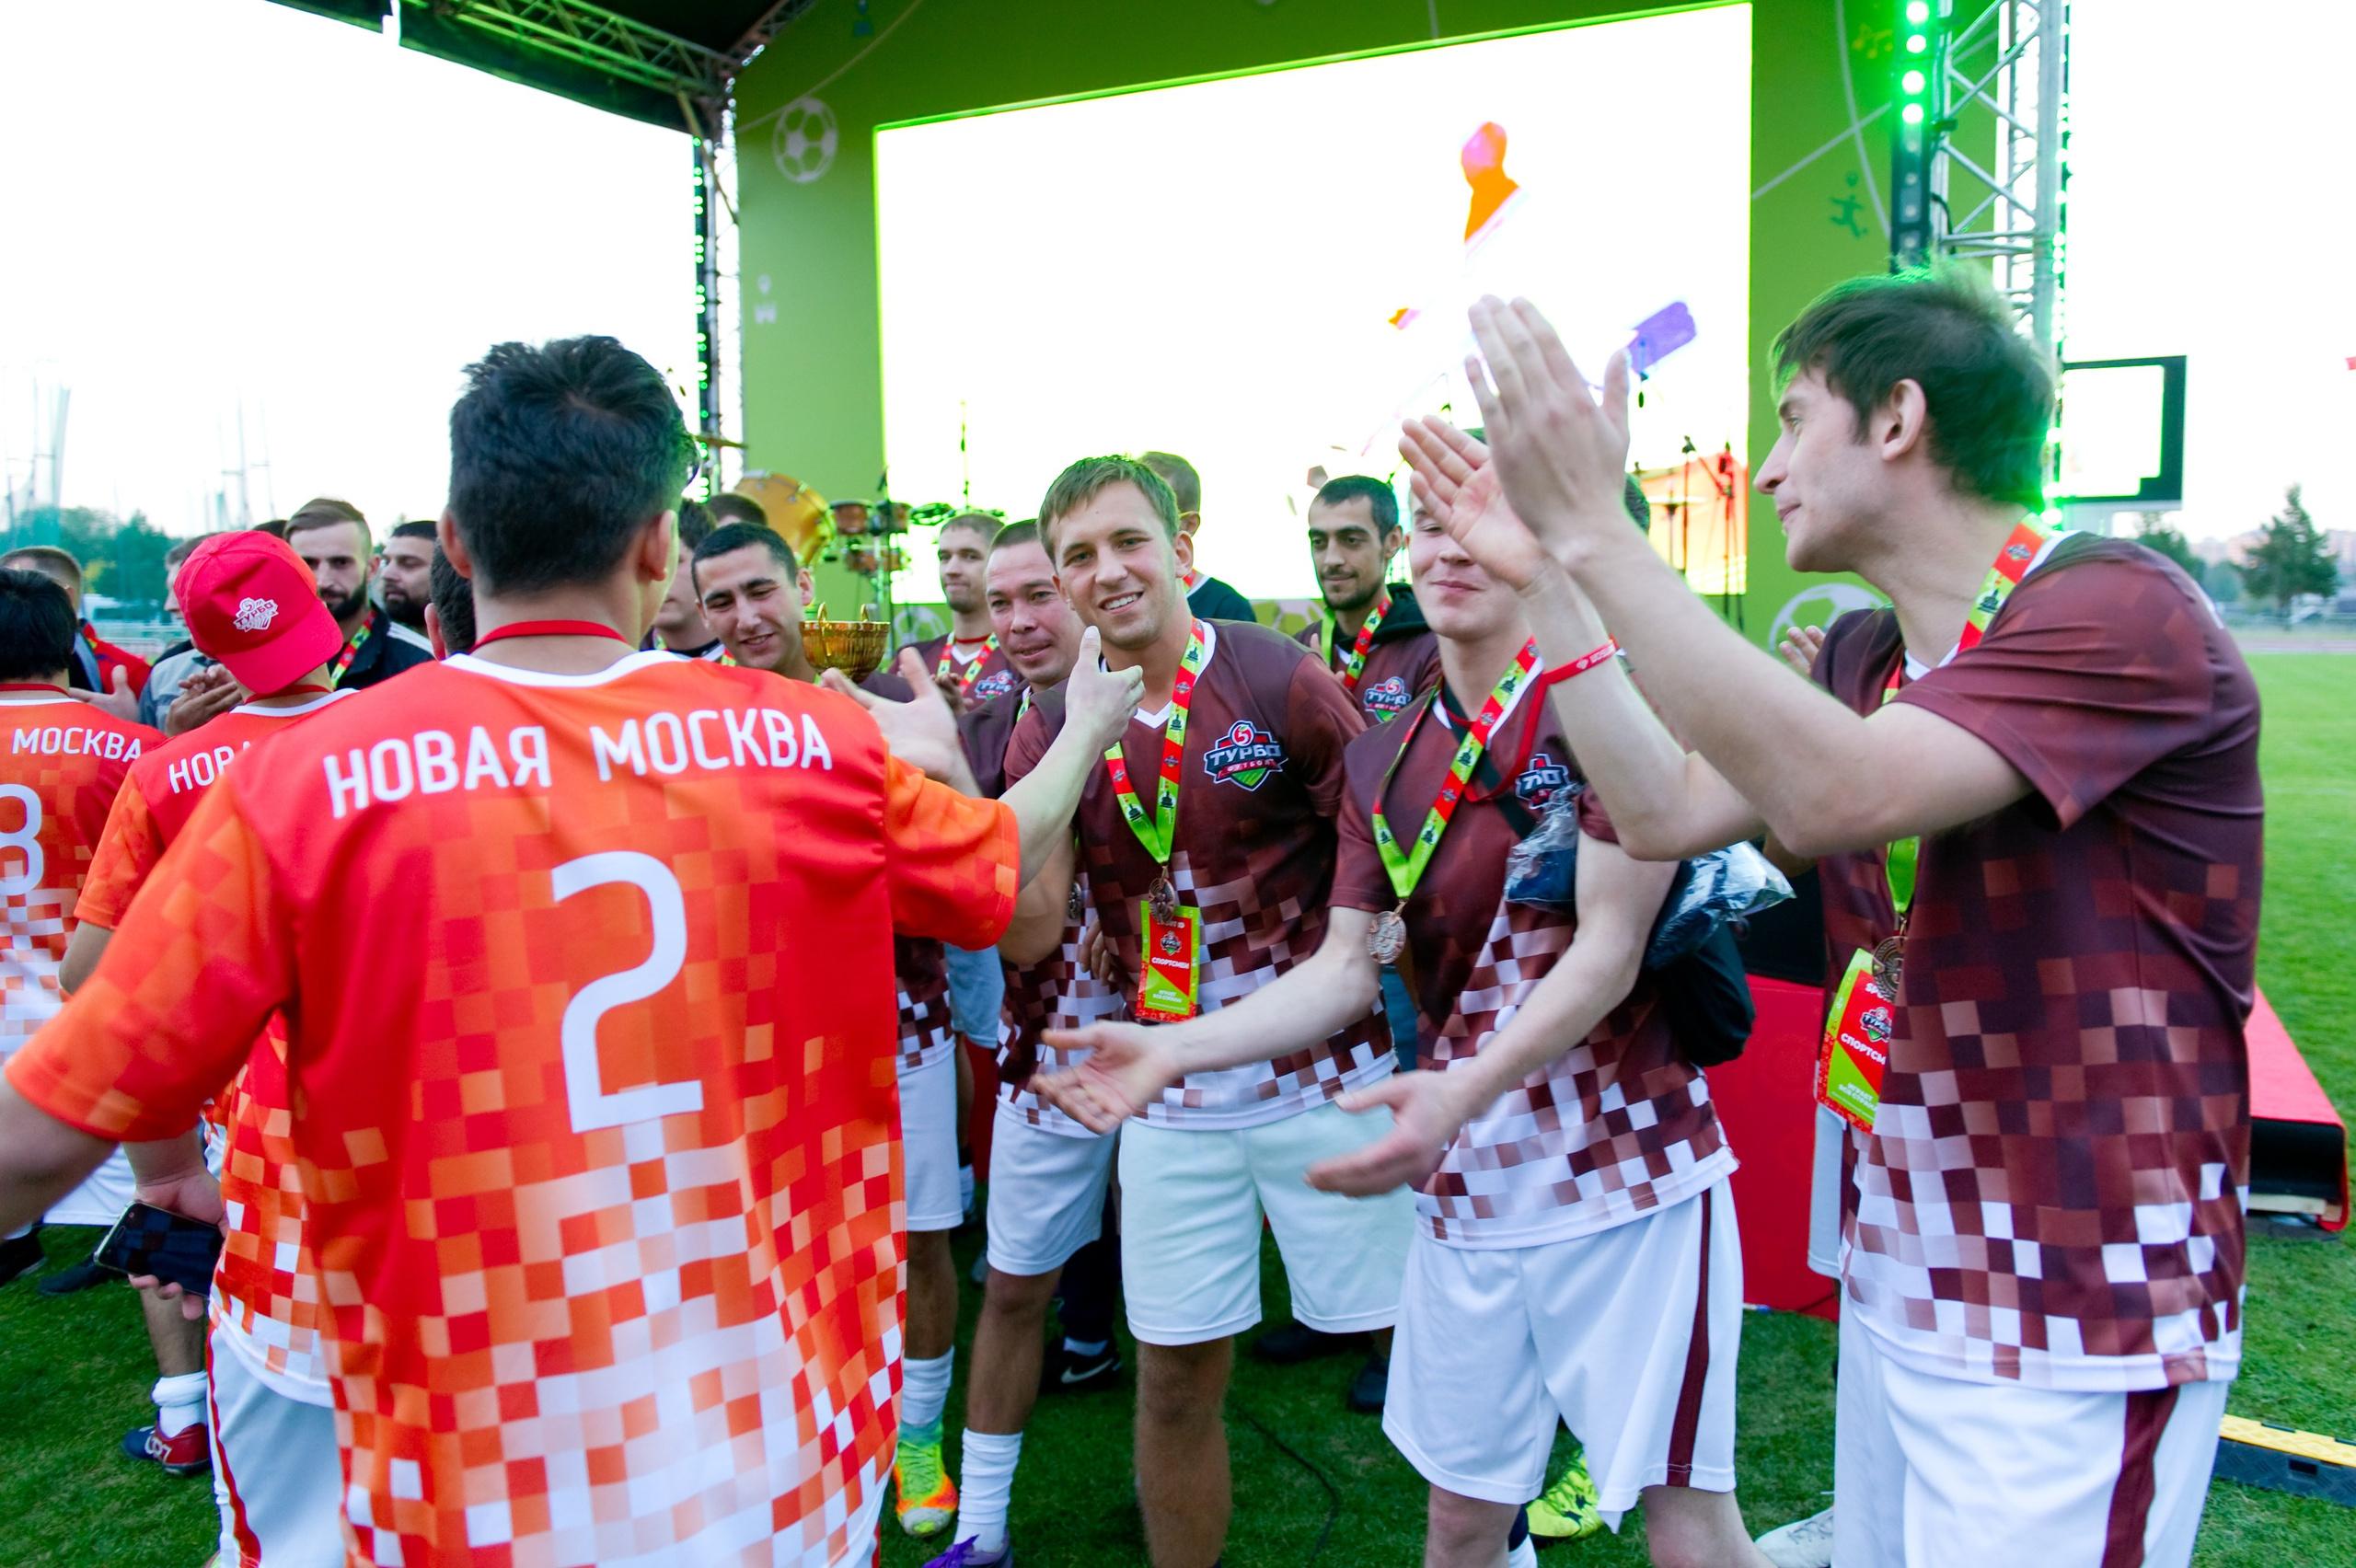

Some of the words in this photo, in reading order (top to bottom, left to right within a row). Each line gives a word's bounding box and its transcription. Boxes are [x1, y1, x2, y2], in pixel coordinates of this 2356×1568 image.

[237, 602, 274, 626] ТУРБО
[12, 727, 142, 763] МОСКВА
[323, 726, 552, 819] НОВАЯ
[589, 709, 833, 781] МОСКВА
[1209, 744, 1282, 767] ТУРБО
[168, 741, 251, 794] НОВ
[0, 783, 44, 896] 8
[552, 850, 703, 1134] 2
[1841, 1032, 1887, 1066] СПОРТСМ
